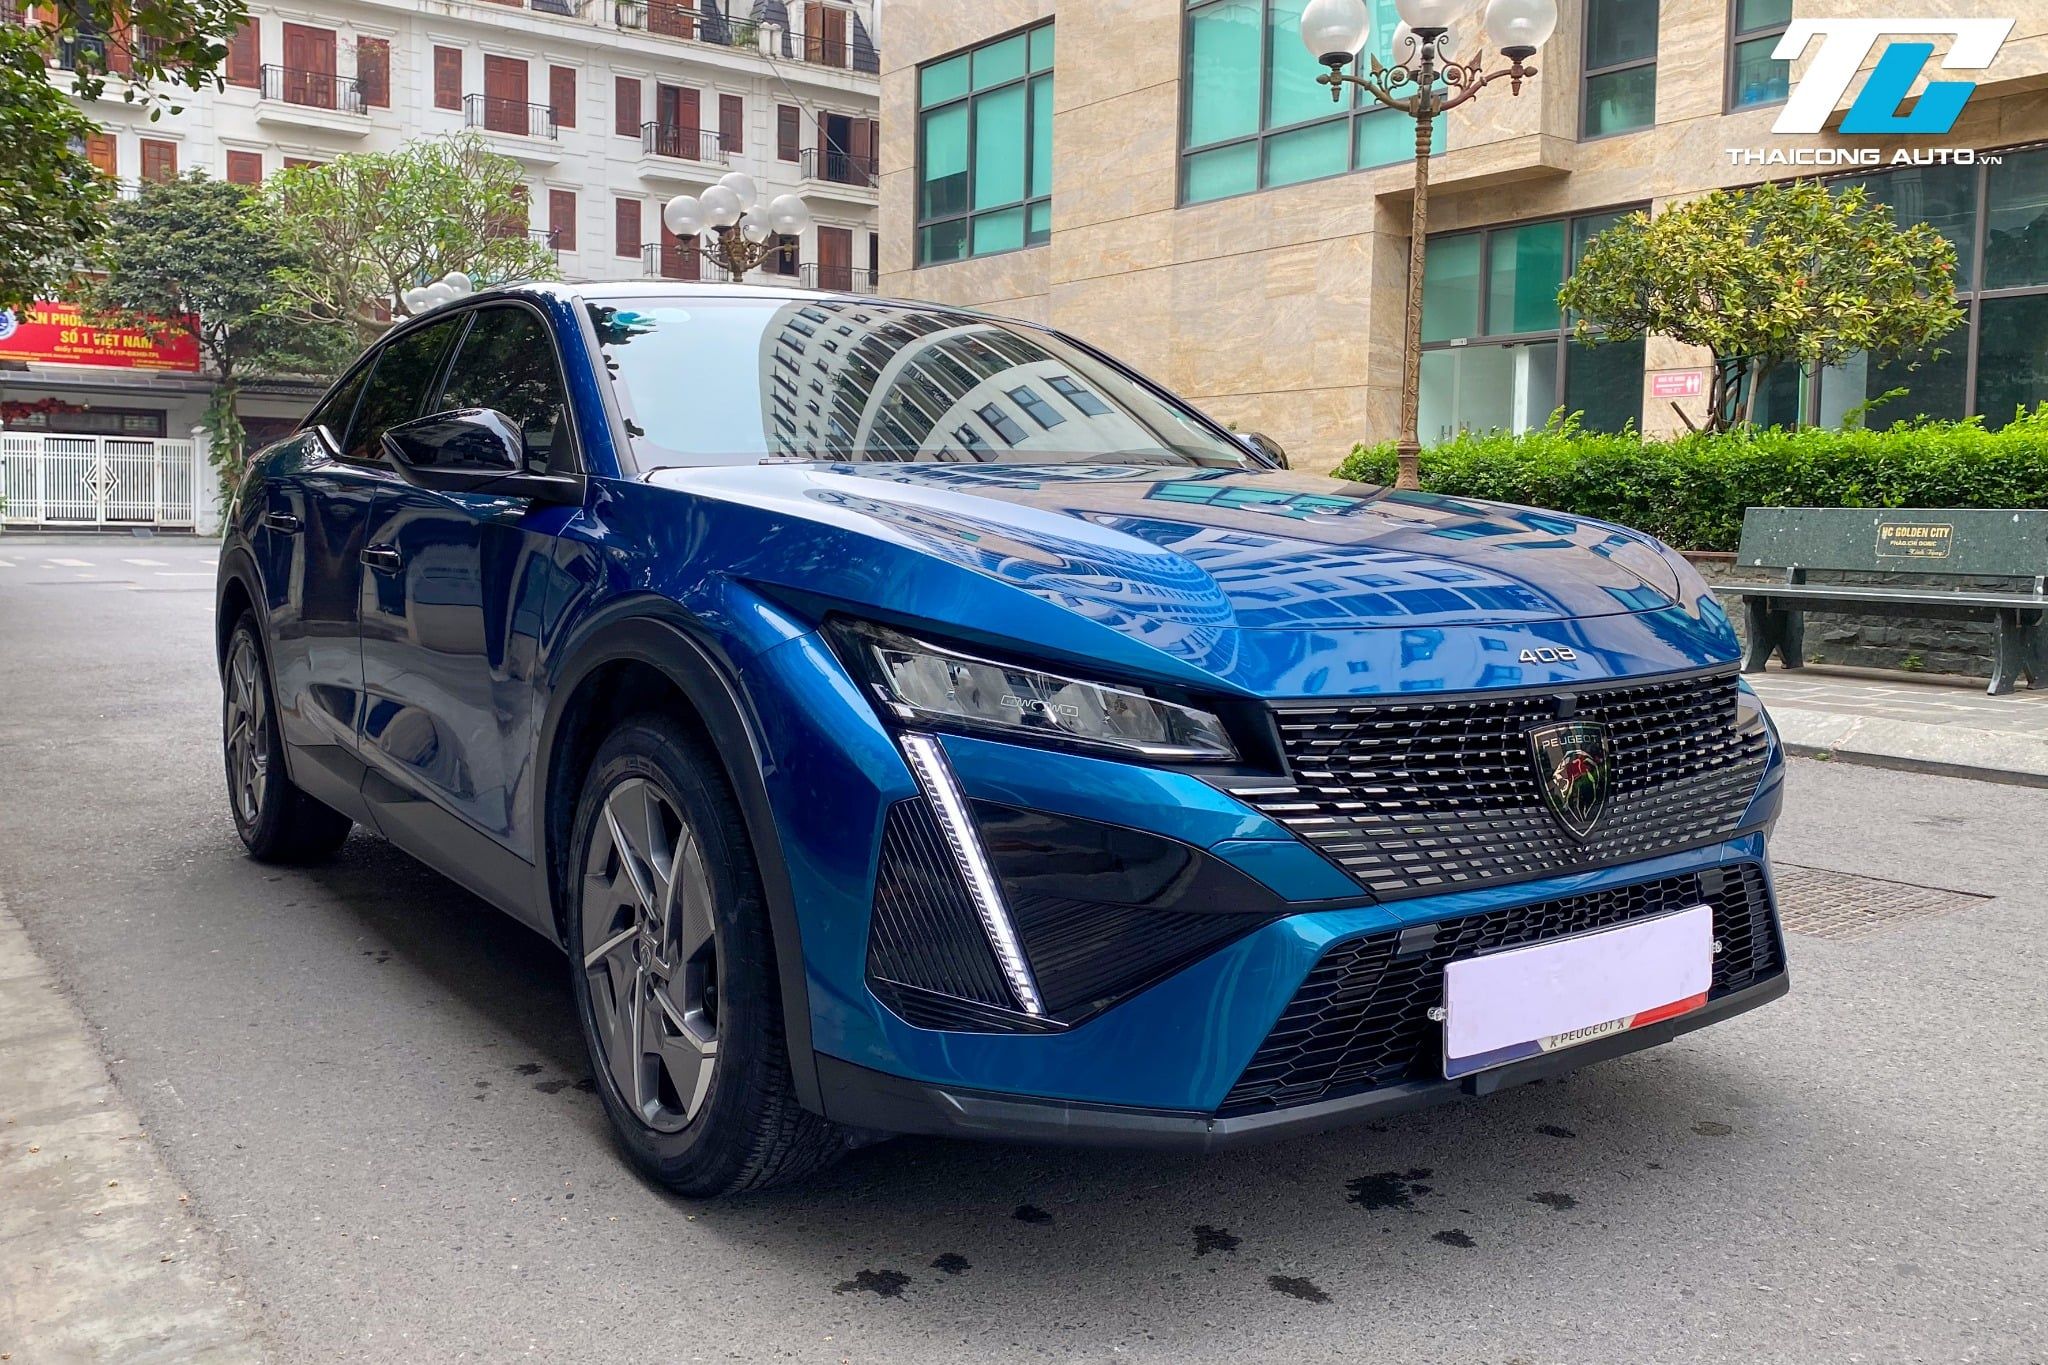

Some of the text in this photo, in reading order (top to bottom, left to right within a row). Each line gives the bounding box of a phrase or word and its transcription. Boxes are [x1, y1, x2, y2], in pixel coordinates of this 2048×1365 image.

[60, 327, 152, 350] SỐ 1 VIỆT NAM
[1895, 527, 1928, 538] GOLDEN
[1930, 528, 1950, 538] CITY
[1519, 647, 1577, 665] 408
[1542, 735, 1598, 750] PEUGEOT
[1560, 1020, 1615, 1043] PEUGEOT
